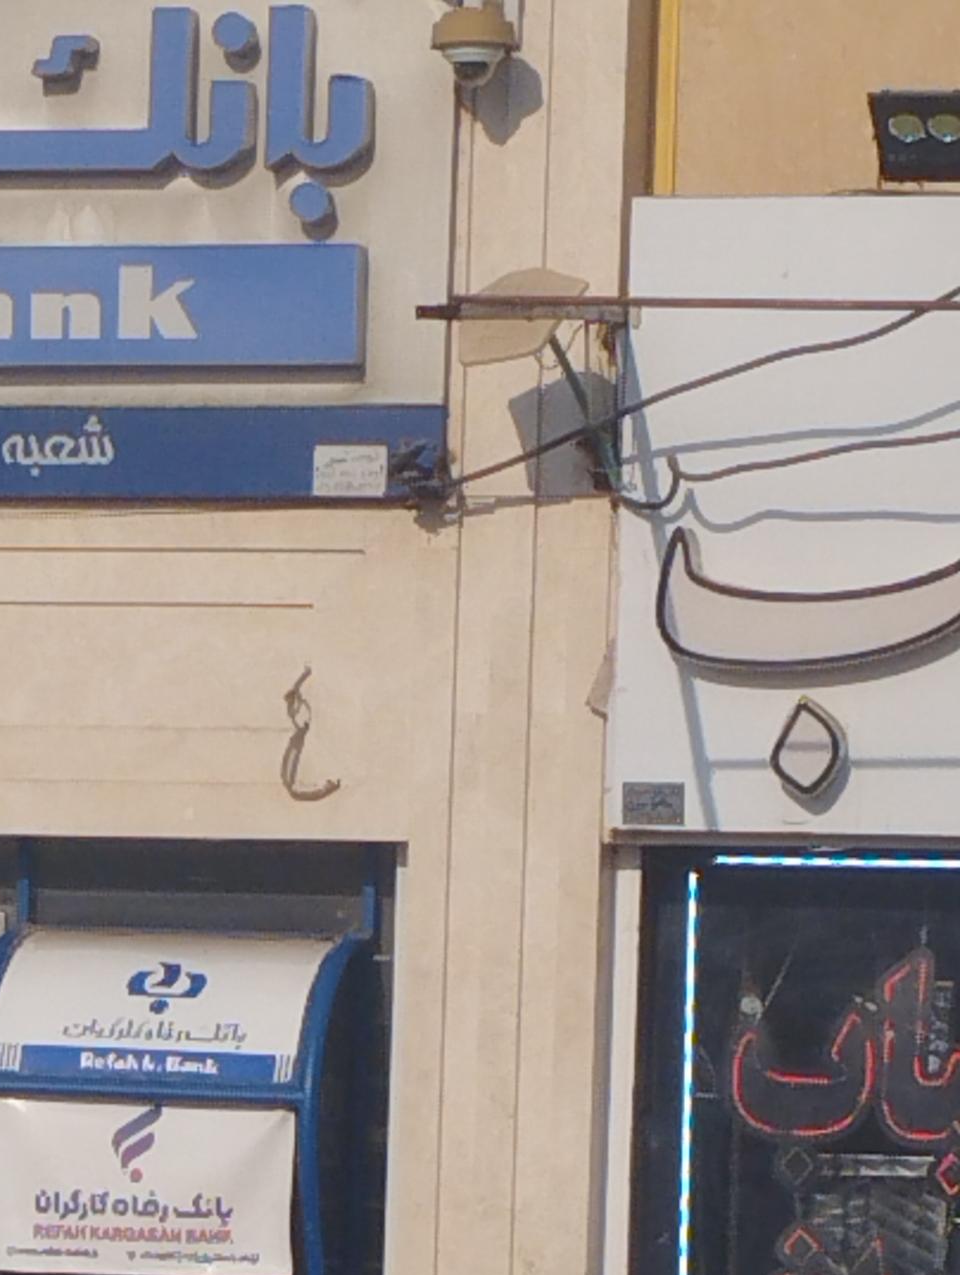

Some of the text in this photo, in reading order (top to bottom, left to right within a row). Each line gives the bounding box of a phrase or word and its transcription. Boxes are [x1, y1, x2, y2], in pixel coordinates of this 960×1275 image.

[1, 415, 115, 477] شعبه
[80, 1051, 139, 1071] Refah
[165, 1055, 220, 1074] Bank
[34, 1189, 234, 1228] بانک رفاه کارگران
